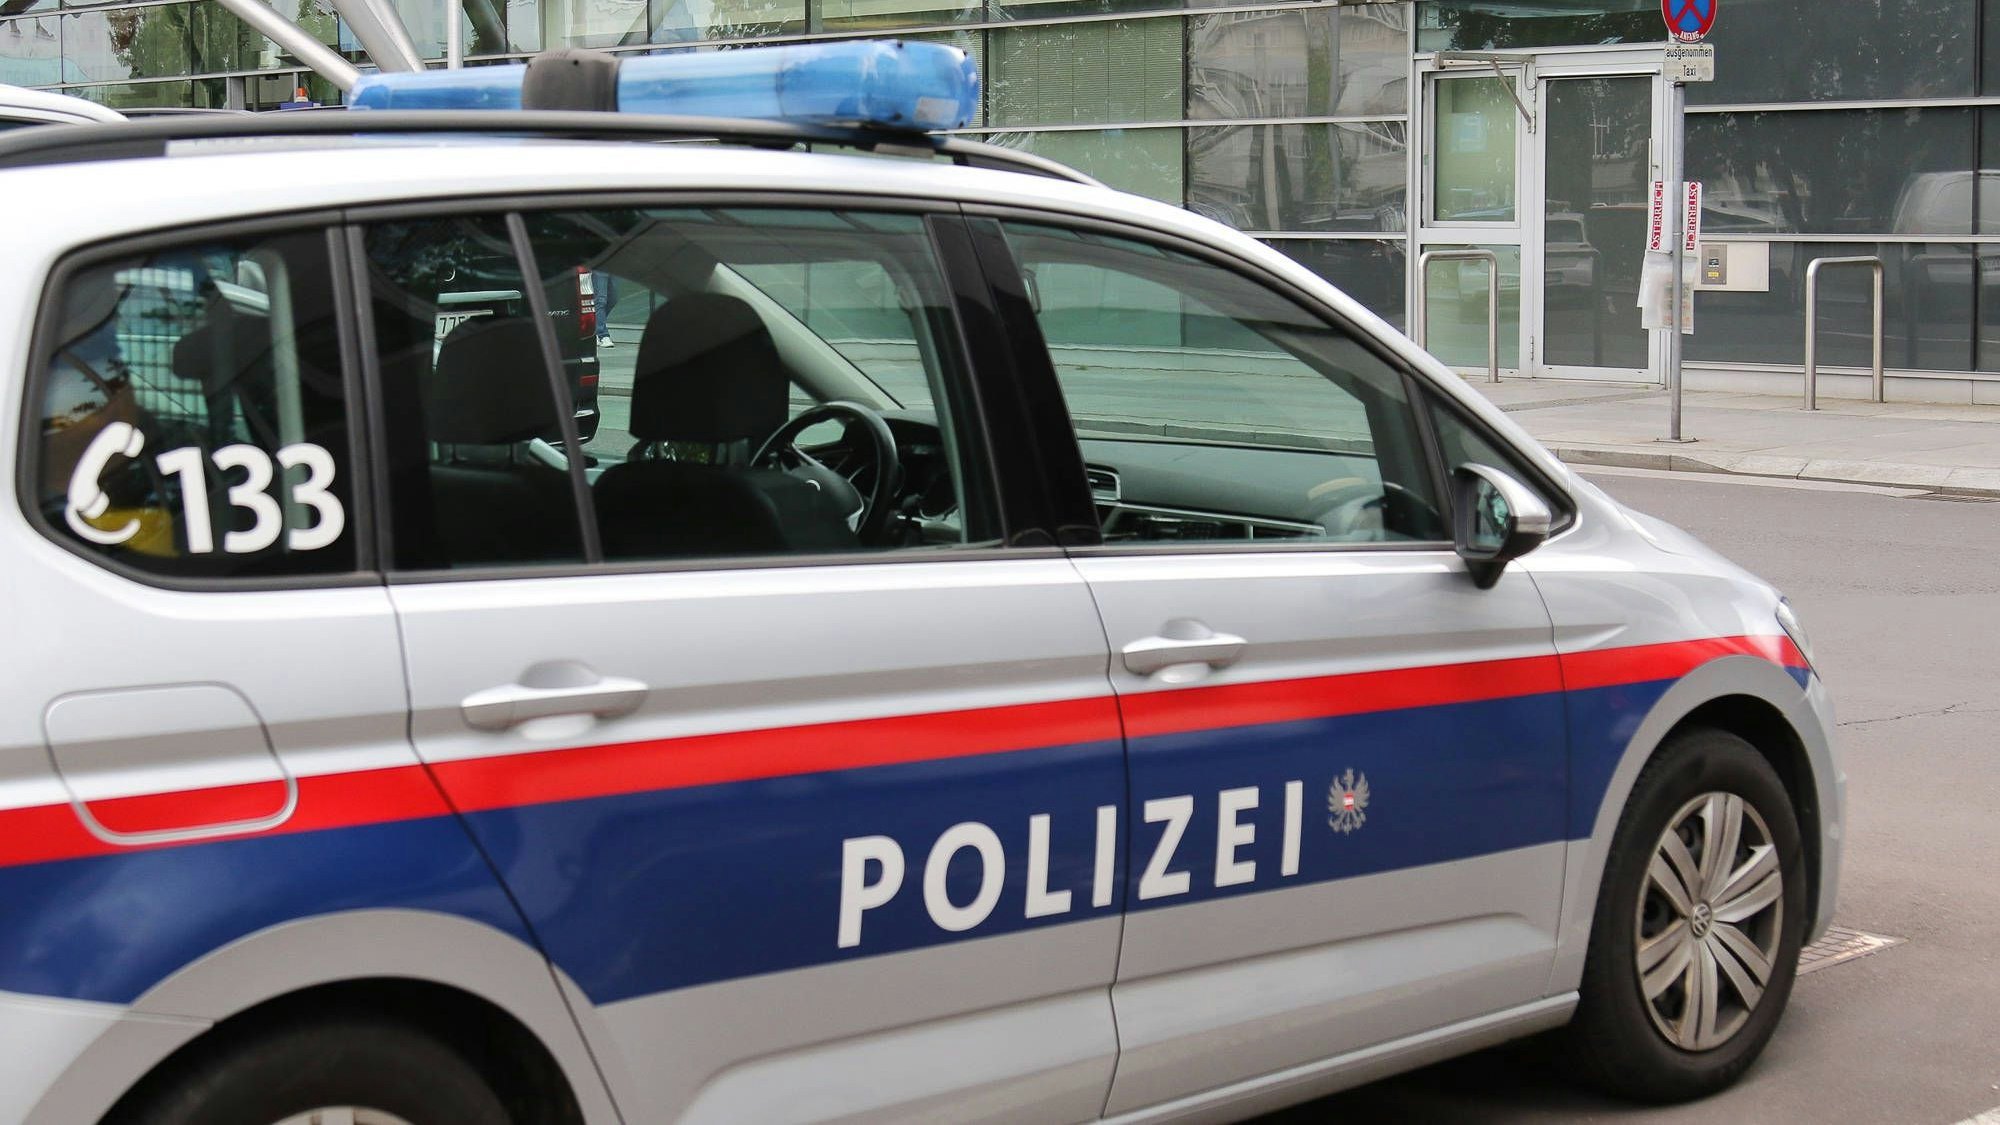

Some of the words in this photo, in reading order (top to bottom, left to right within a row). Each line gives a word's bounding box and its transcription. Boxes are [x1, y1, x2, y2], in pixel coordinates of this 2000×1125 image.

[1680, 30, 1700, 41] ANFANG
[1666, 48, 1713, 60] ausgenommen
[1683, 64, 1697, 77] Taxi
[156, 443, 345, 554] 133
[837, 780, 1303, 948] POLIZEI
